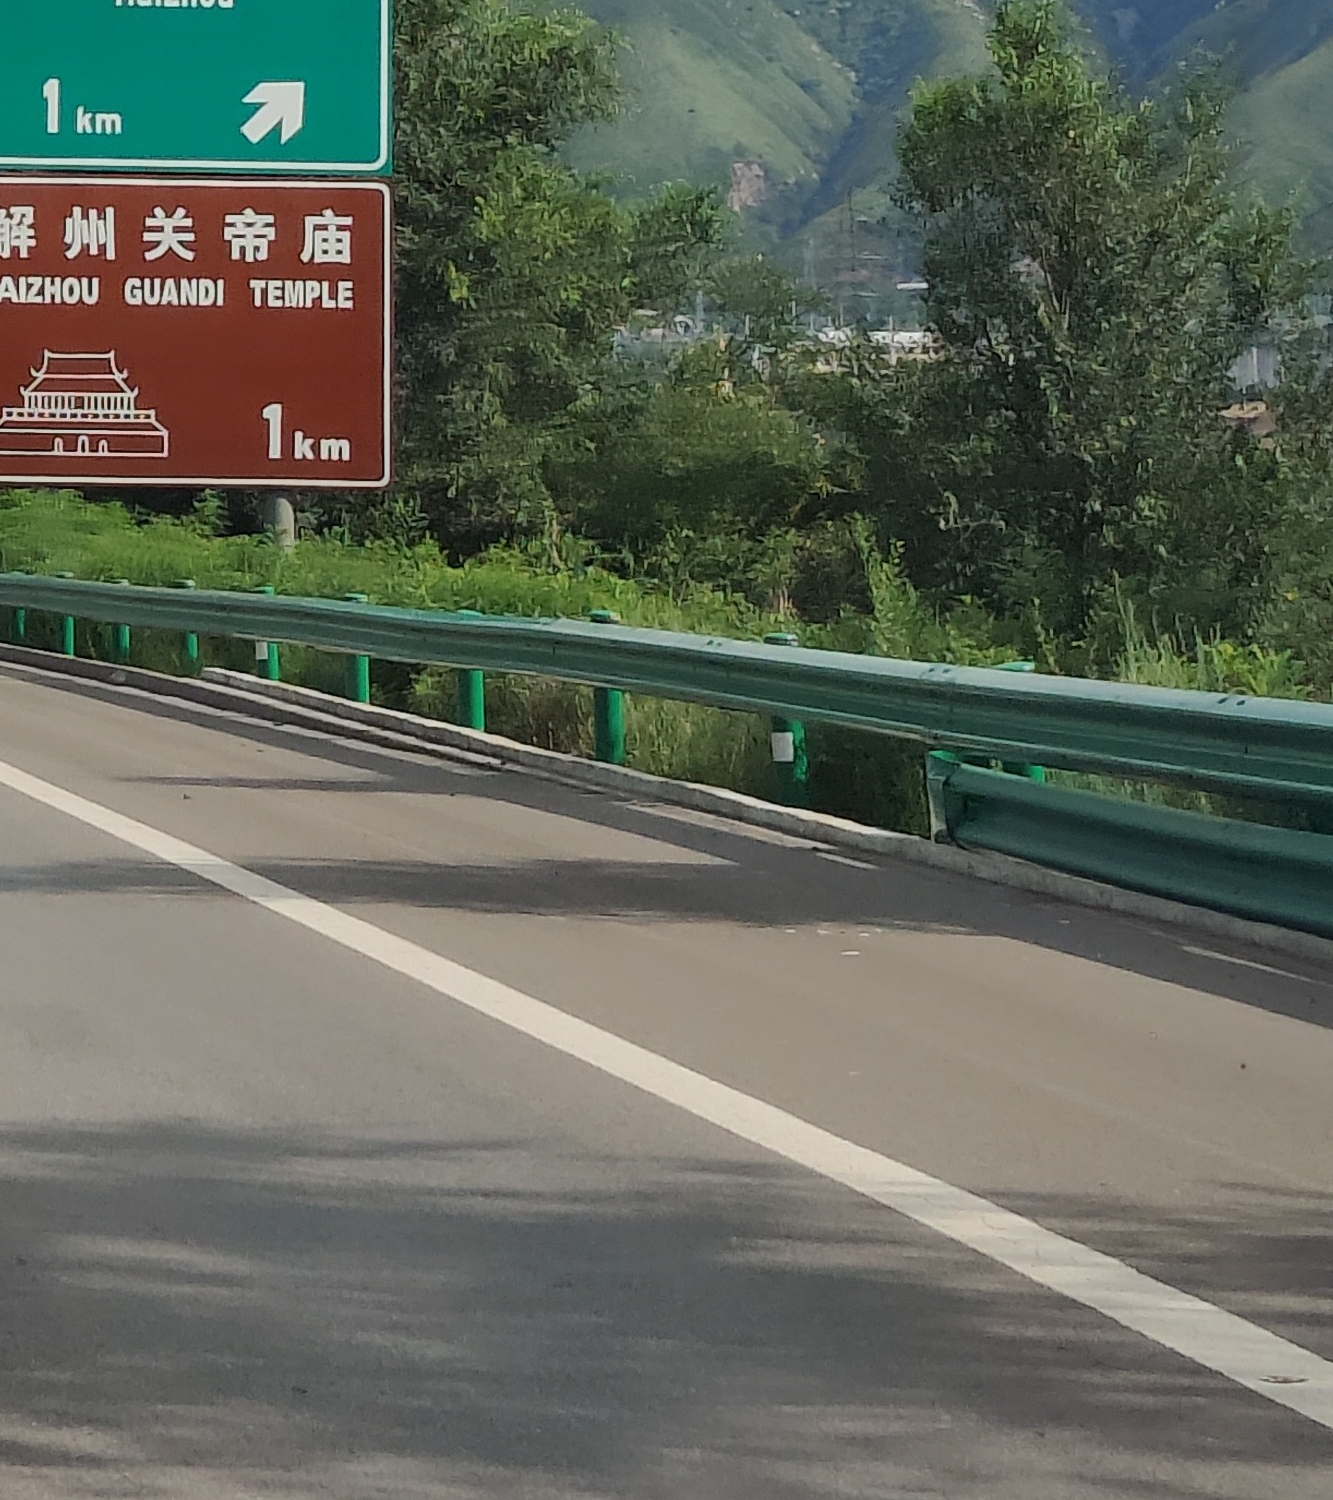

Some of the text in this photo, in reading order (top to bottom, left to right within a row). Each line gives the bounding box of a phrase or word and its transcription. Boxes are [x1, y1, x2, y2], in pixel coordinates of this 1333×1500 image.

[42, 78, 123, 135] 1 km
[123, 277, 225, 306] GUANDI
[249, 279, 354, 309] TEMPLE
[261, 403, 351, 461] 1 km
